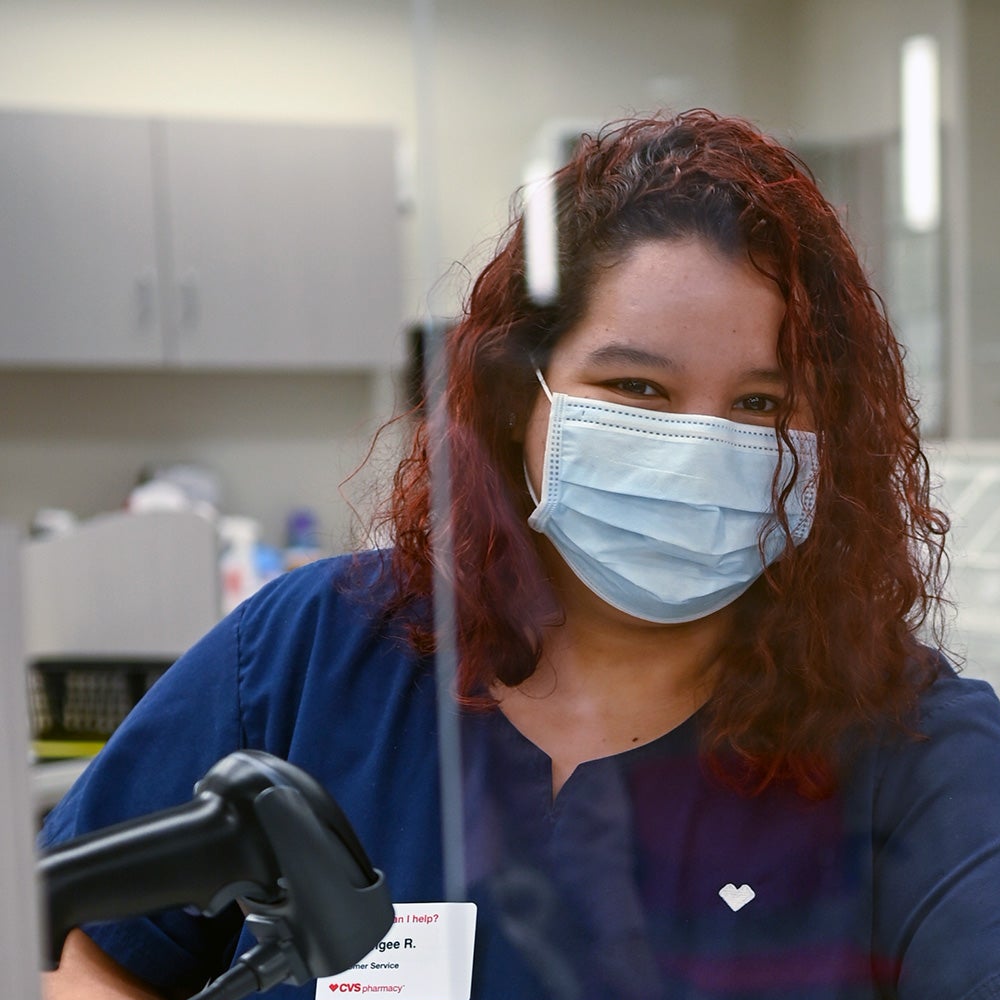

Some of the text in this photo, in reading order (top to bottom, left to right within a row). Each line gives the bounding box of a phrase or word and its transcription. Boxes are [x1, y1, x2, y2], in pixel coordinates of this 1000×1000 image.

[407, 914, 410, 923] I
[412, 913, 439, 925] help?
[375, 938, 416, 953] gee R.
[370, 962, 400, 970] Service
[339, 983, 404, 994] CVS pharmacy
